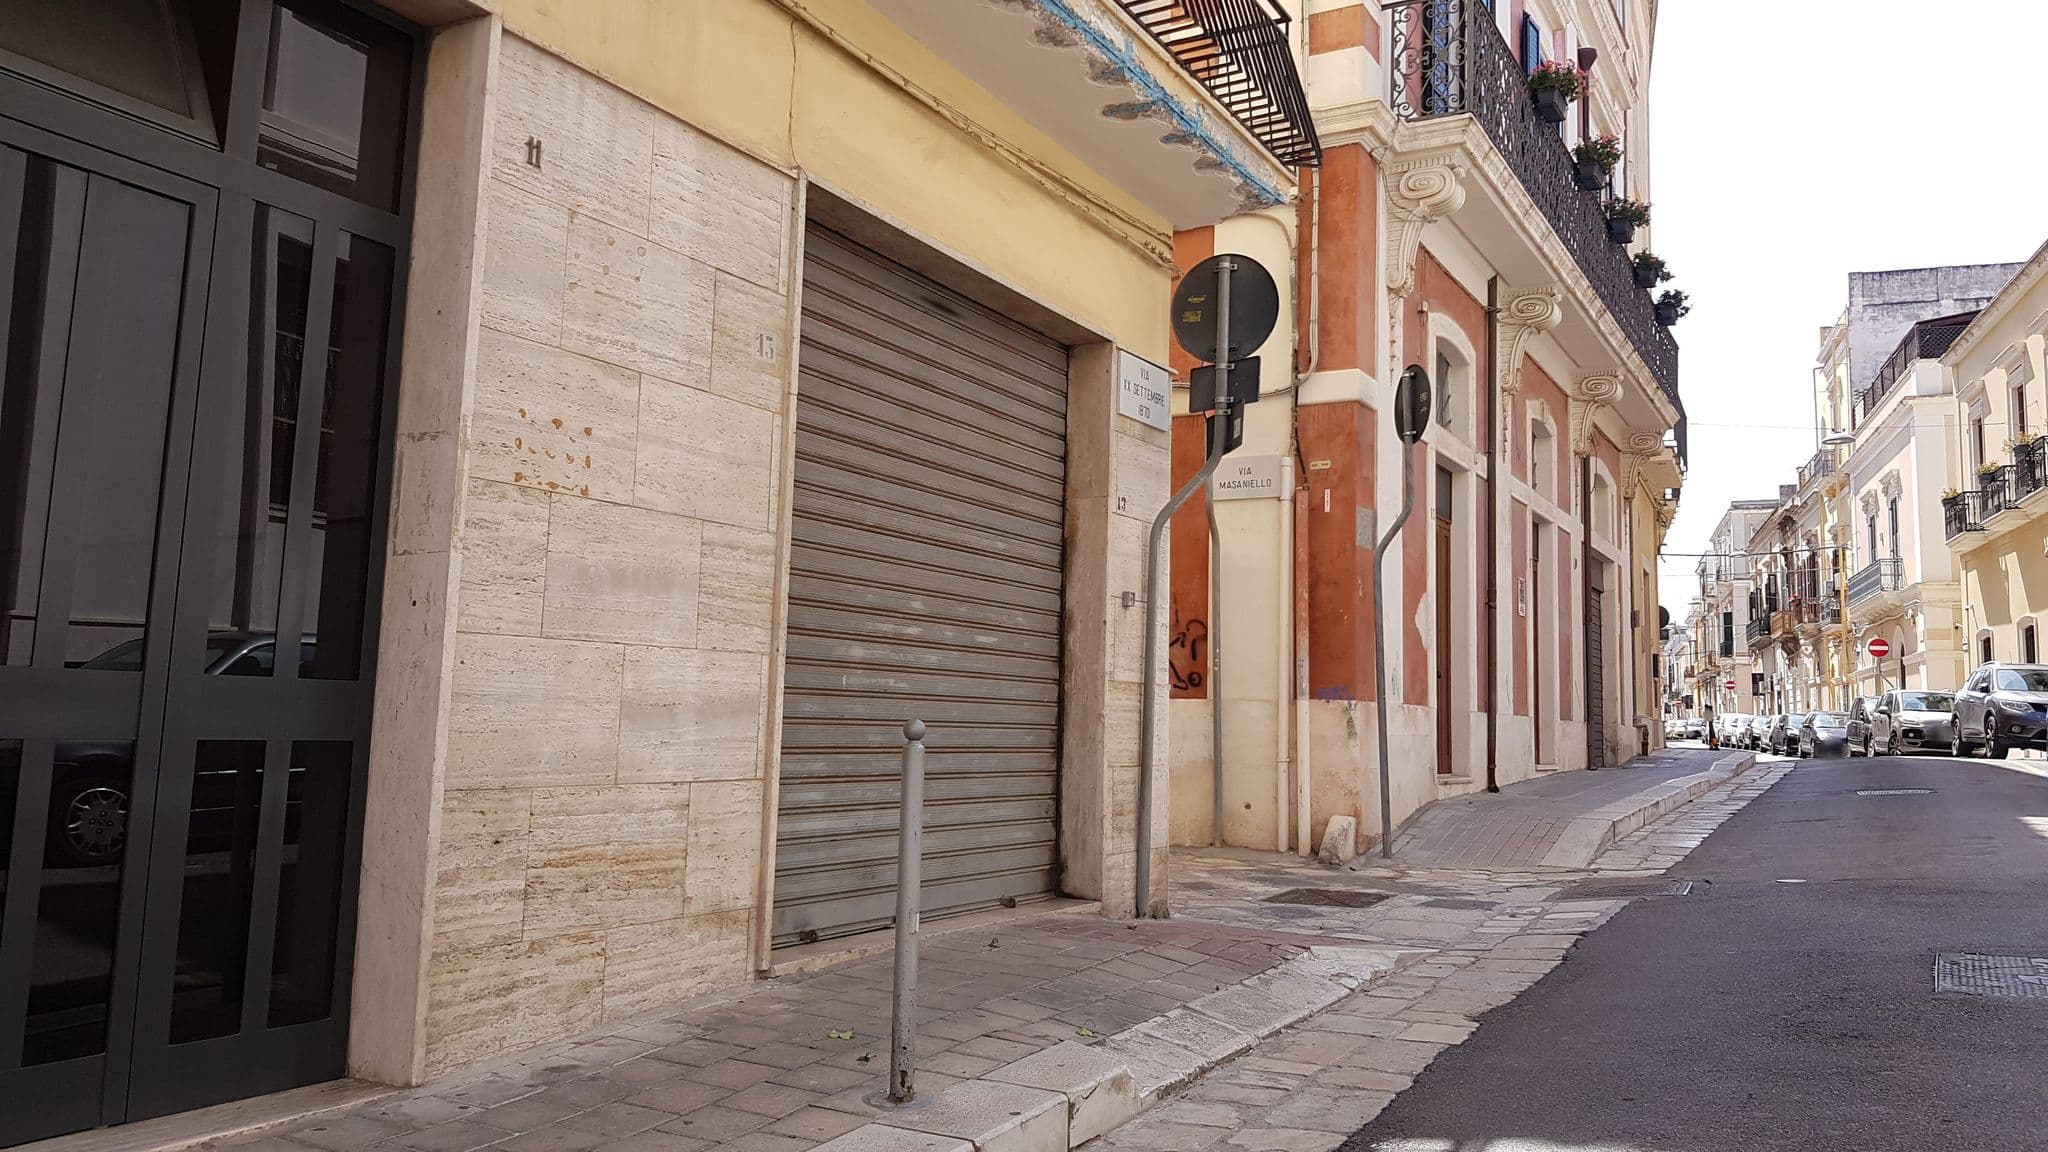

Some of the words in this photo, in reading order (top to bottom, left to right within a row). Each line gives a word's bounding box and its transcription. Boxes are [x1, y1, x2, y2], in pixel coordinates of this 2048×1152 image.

[523, 135, 542, 169] 11
[1139, 366, 1151, 383] VIA
[1123, 378, 1132, 393] XX
[1133, 382, 1166, 408] SETTEMBRE
[1238, 466, 1252, 476] VIA
[1219, 478, 1272, 490] MASANIELLO
[1117, 495, 1127, 512] 13
